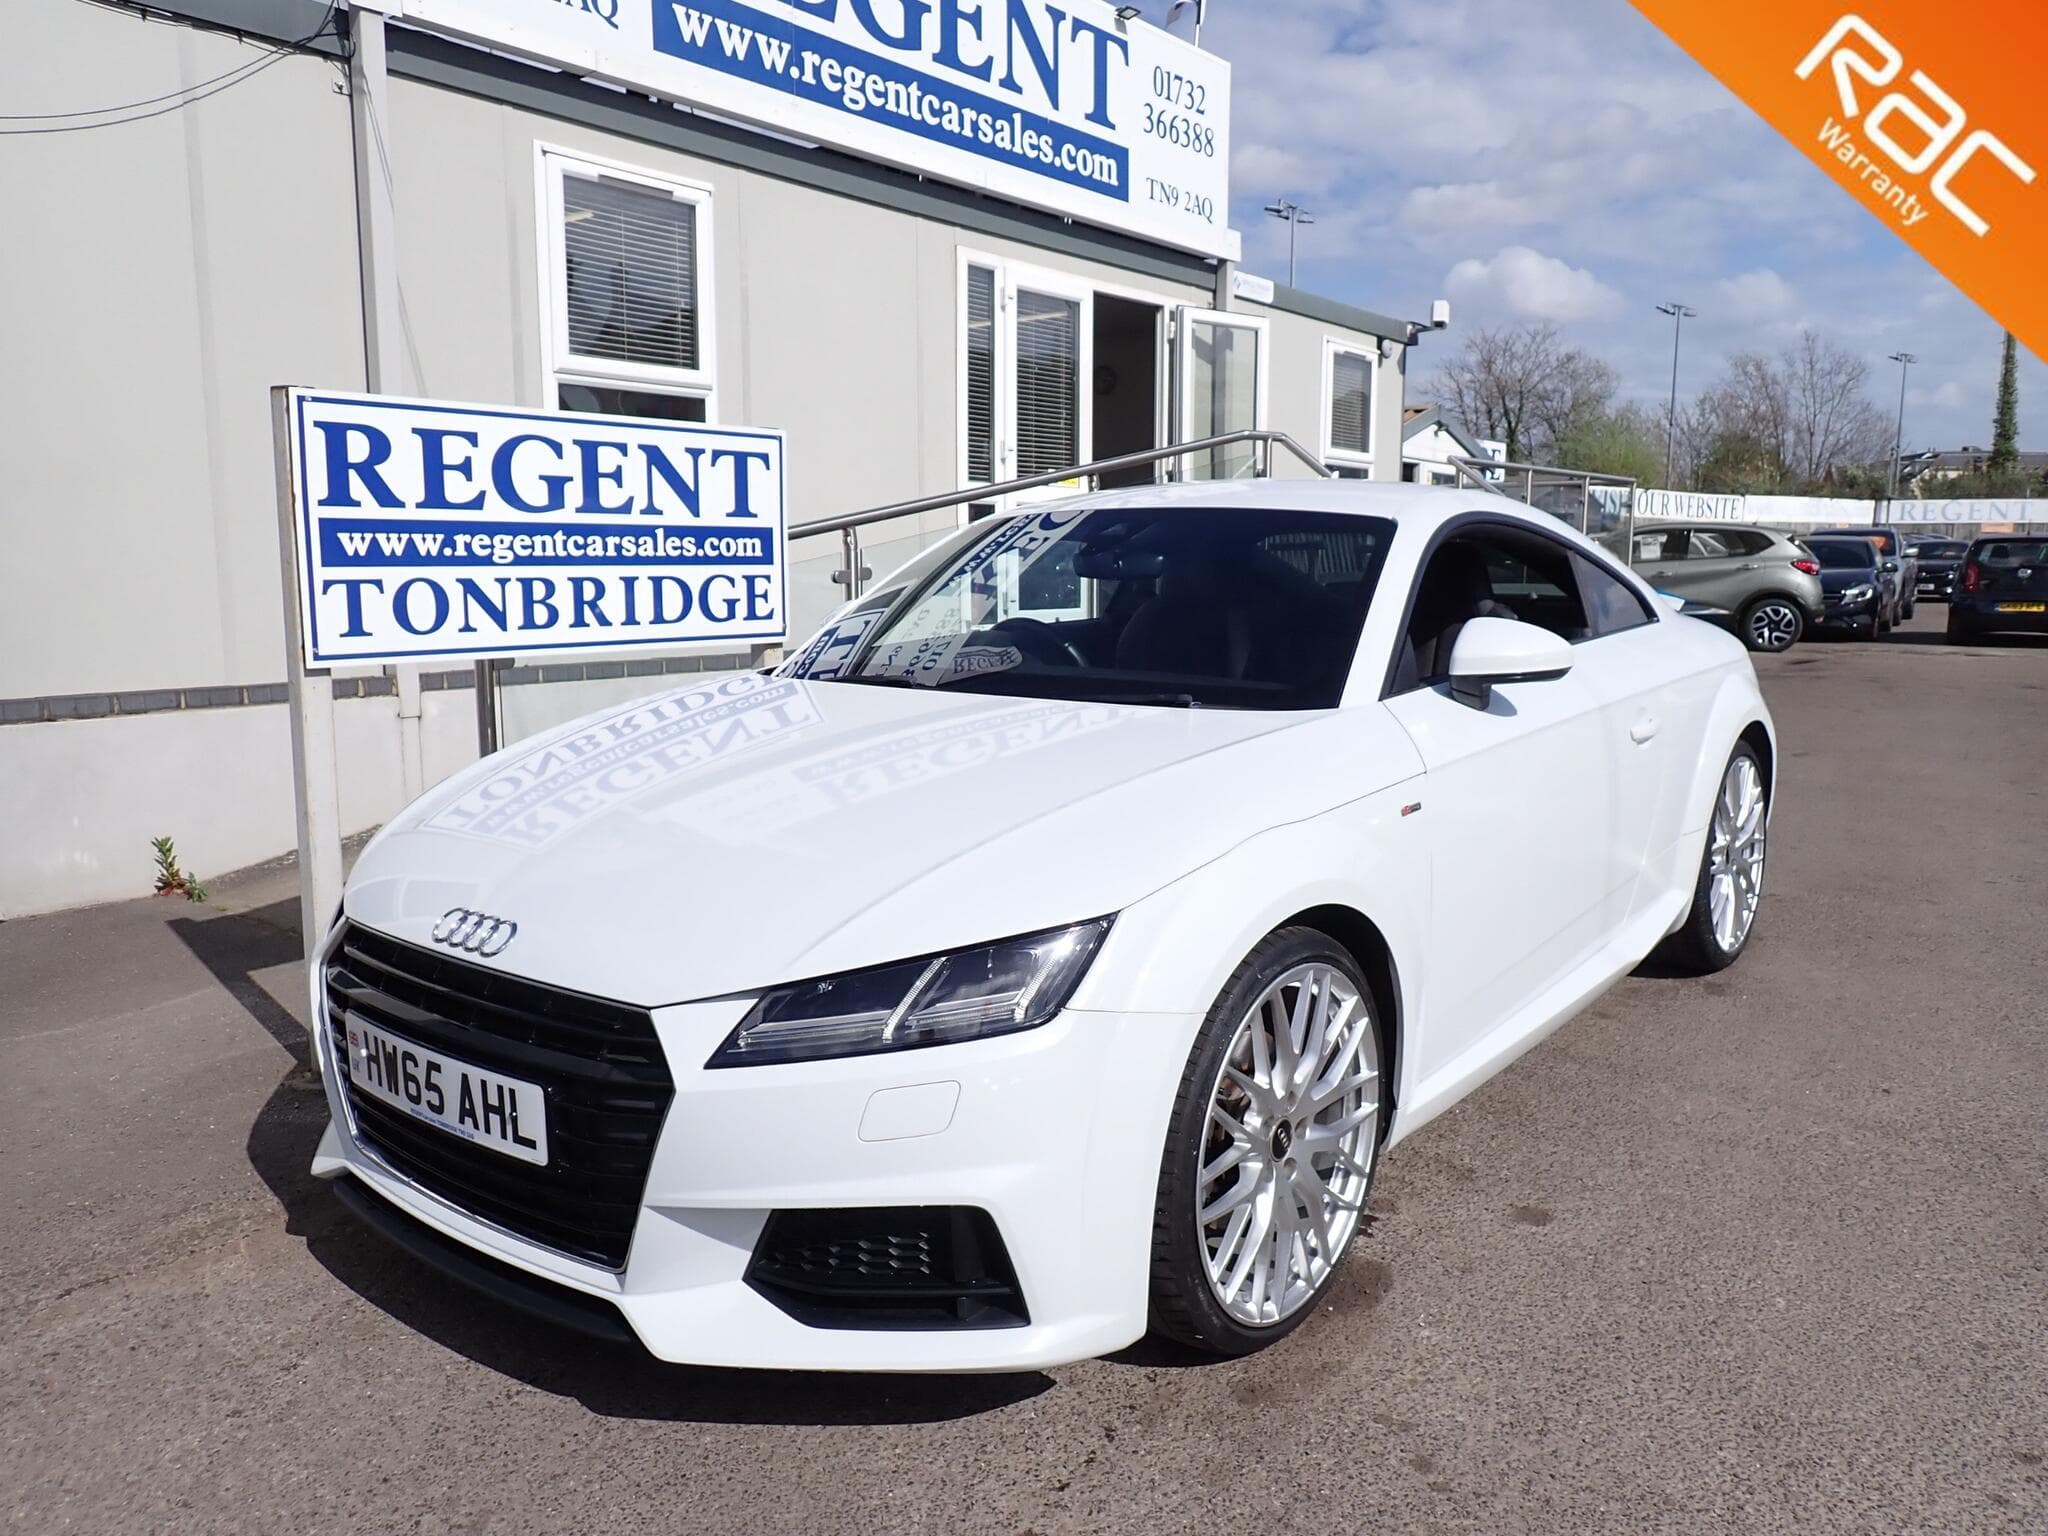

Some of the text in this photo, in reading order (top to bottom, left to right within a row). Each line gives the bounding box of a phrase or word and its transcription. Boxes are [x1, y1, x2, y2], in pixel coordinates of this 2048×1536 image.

[671, 3, 1119, 187] www.regentcarsales.com
[1152, 65, 1206, 115] 01732
[1143, 103, 1215, 158] 366388
[1146, 177, 1214, 224] TN9 2AQ
[313, 420, 771, 519] REGENT
[1637, 490, 1670, 517] OUR
[1674, 494, 1740, 520] WEBSITE
[1900, 500, 2034, 522] REGENT
[336, 528, 763, 564] www.regentcarsales.com
[322, 573, 775, 637] TONBRIDGE
[363, 1030, 537, 1151] HW65 AHL
